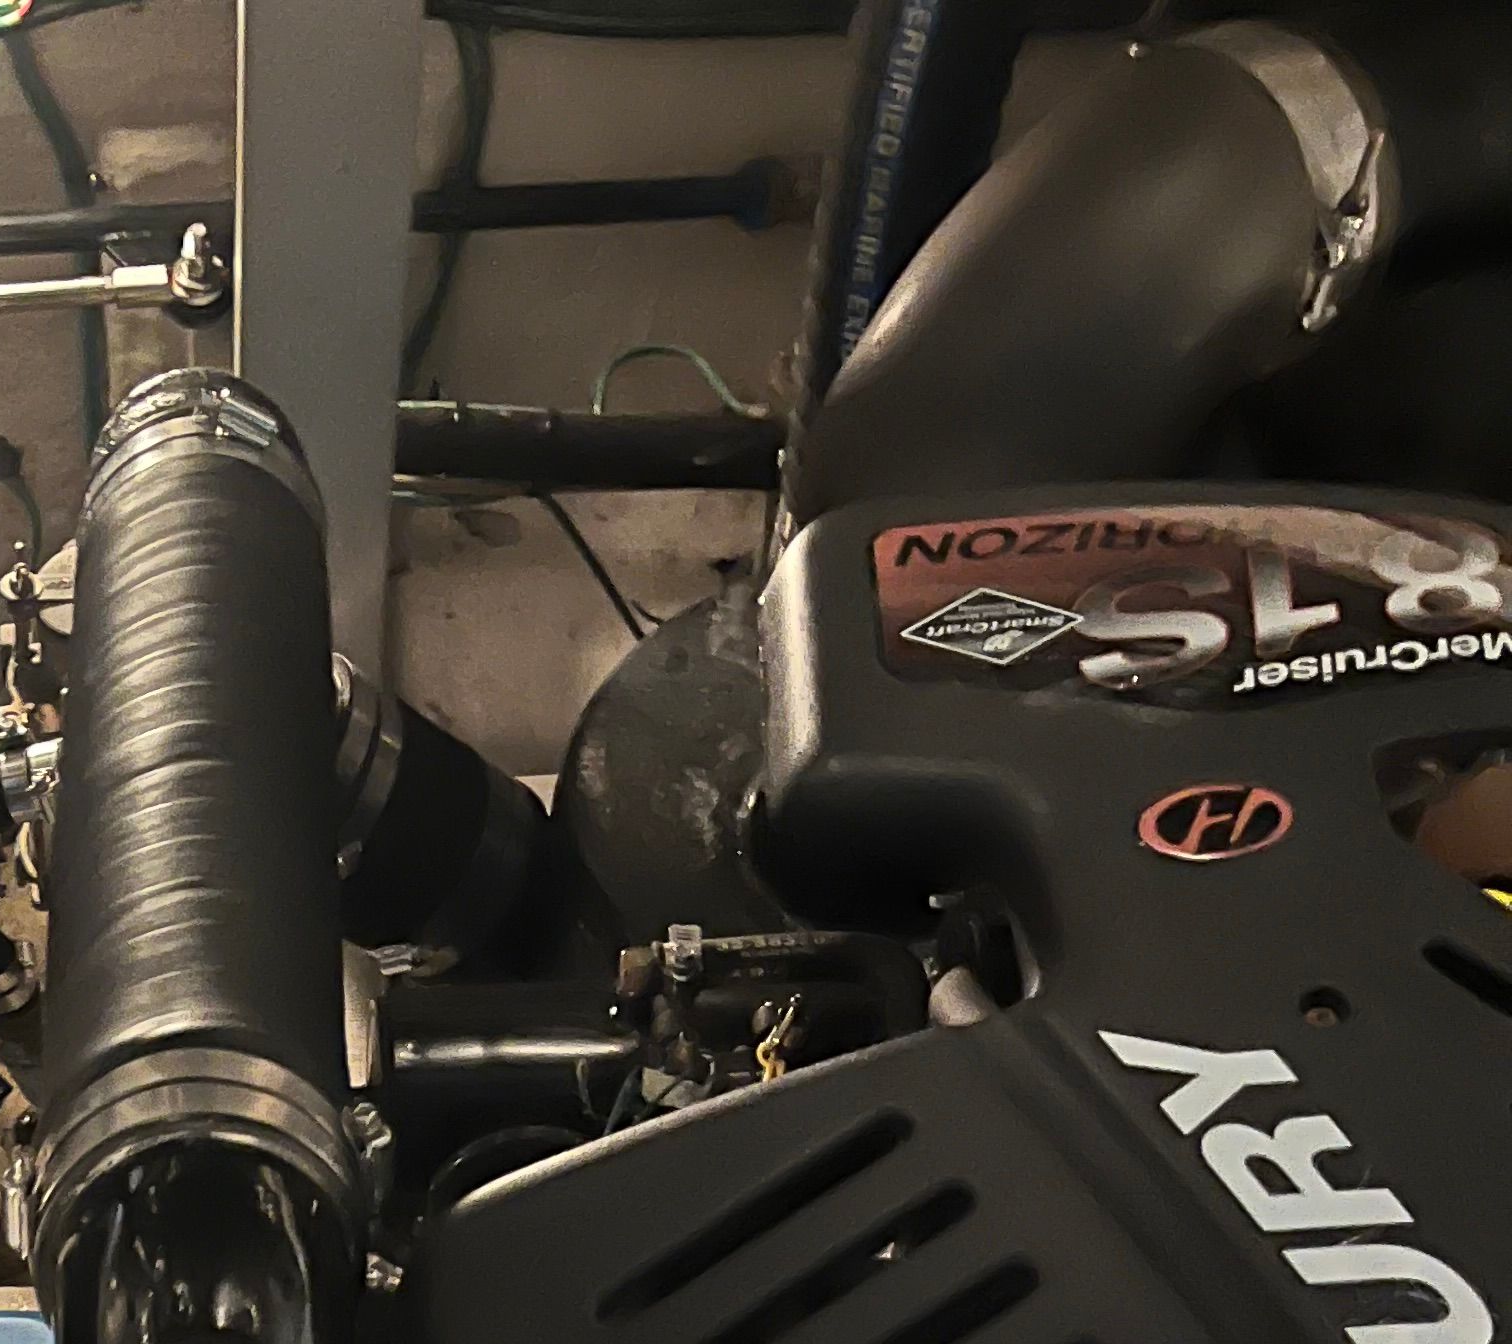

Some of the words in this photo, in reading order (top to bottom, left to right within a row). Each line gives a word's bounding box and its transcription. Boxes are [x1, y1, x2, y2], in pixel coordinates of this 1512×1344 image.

[893, 518, 1230, 568] ORIZON
[925, 614, 1066, 638] SmartCraft
[1232, 631, 1512, 694] MerCruiser
